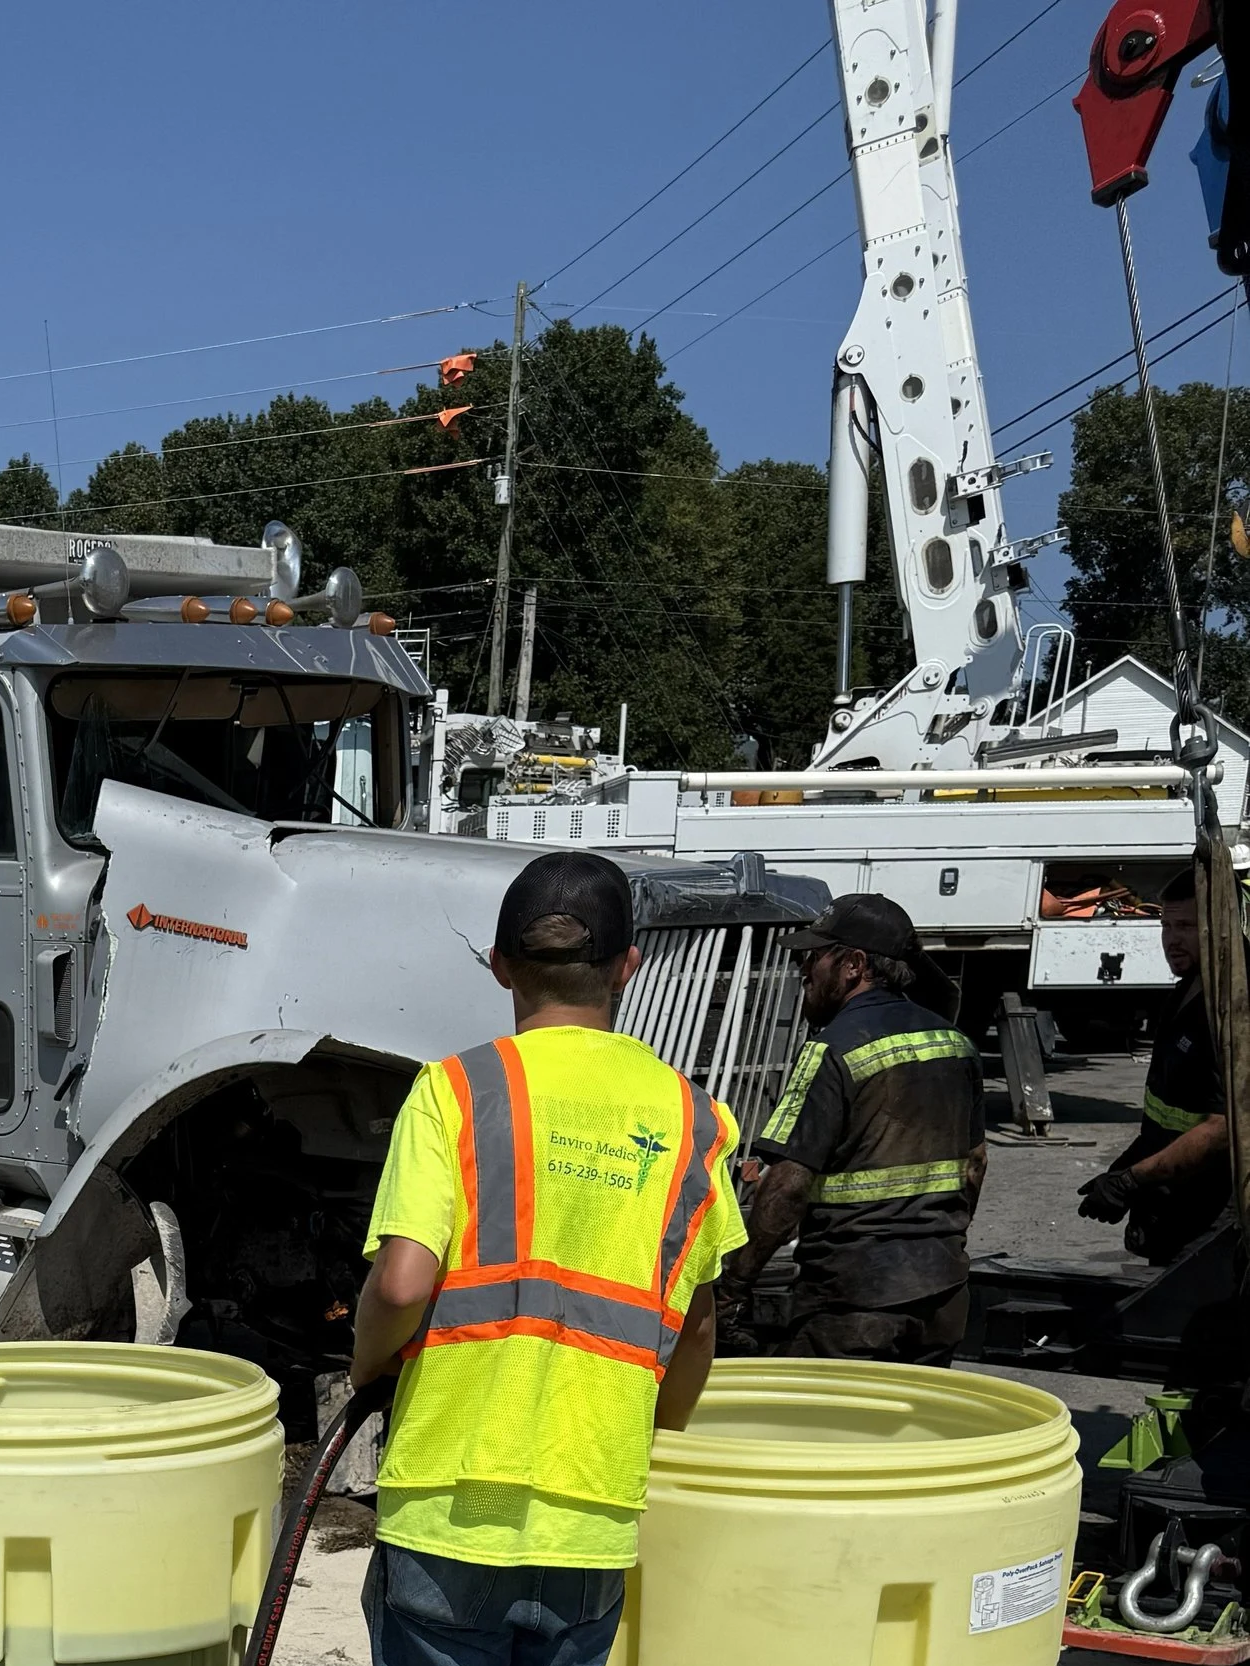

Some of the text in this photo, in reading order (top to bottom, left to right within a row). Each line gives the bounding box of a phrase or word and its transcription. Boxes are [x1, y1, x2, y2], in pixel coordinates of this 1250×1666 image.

[154, 914, 248, 947] INTERNATIONAL
[550, 1131, 638, 1163] Enviro Medics
[548, 1159, 634, 1190] 615-239-1505
